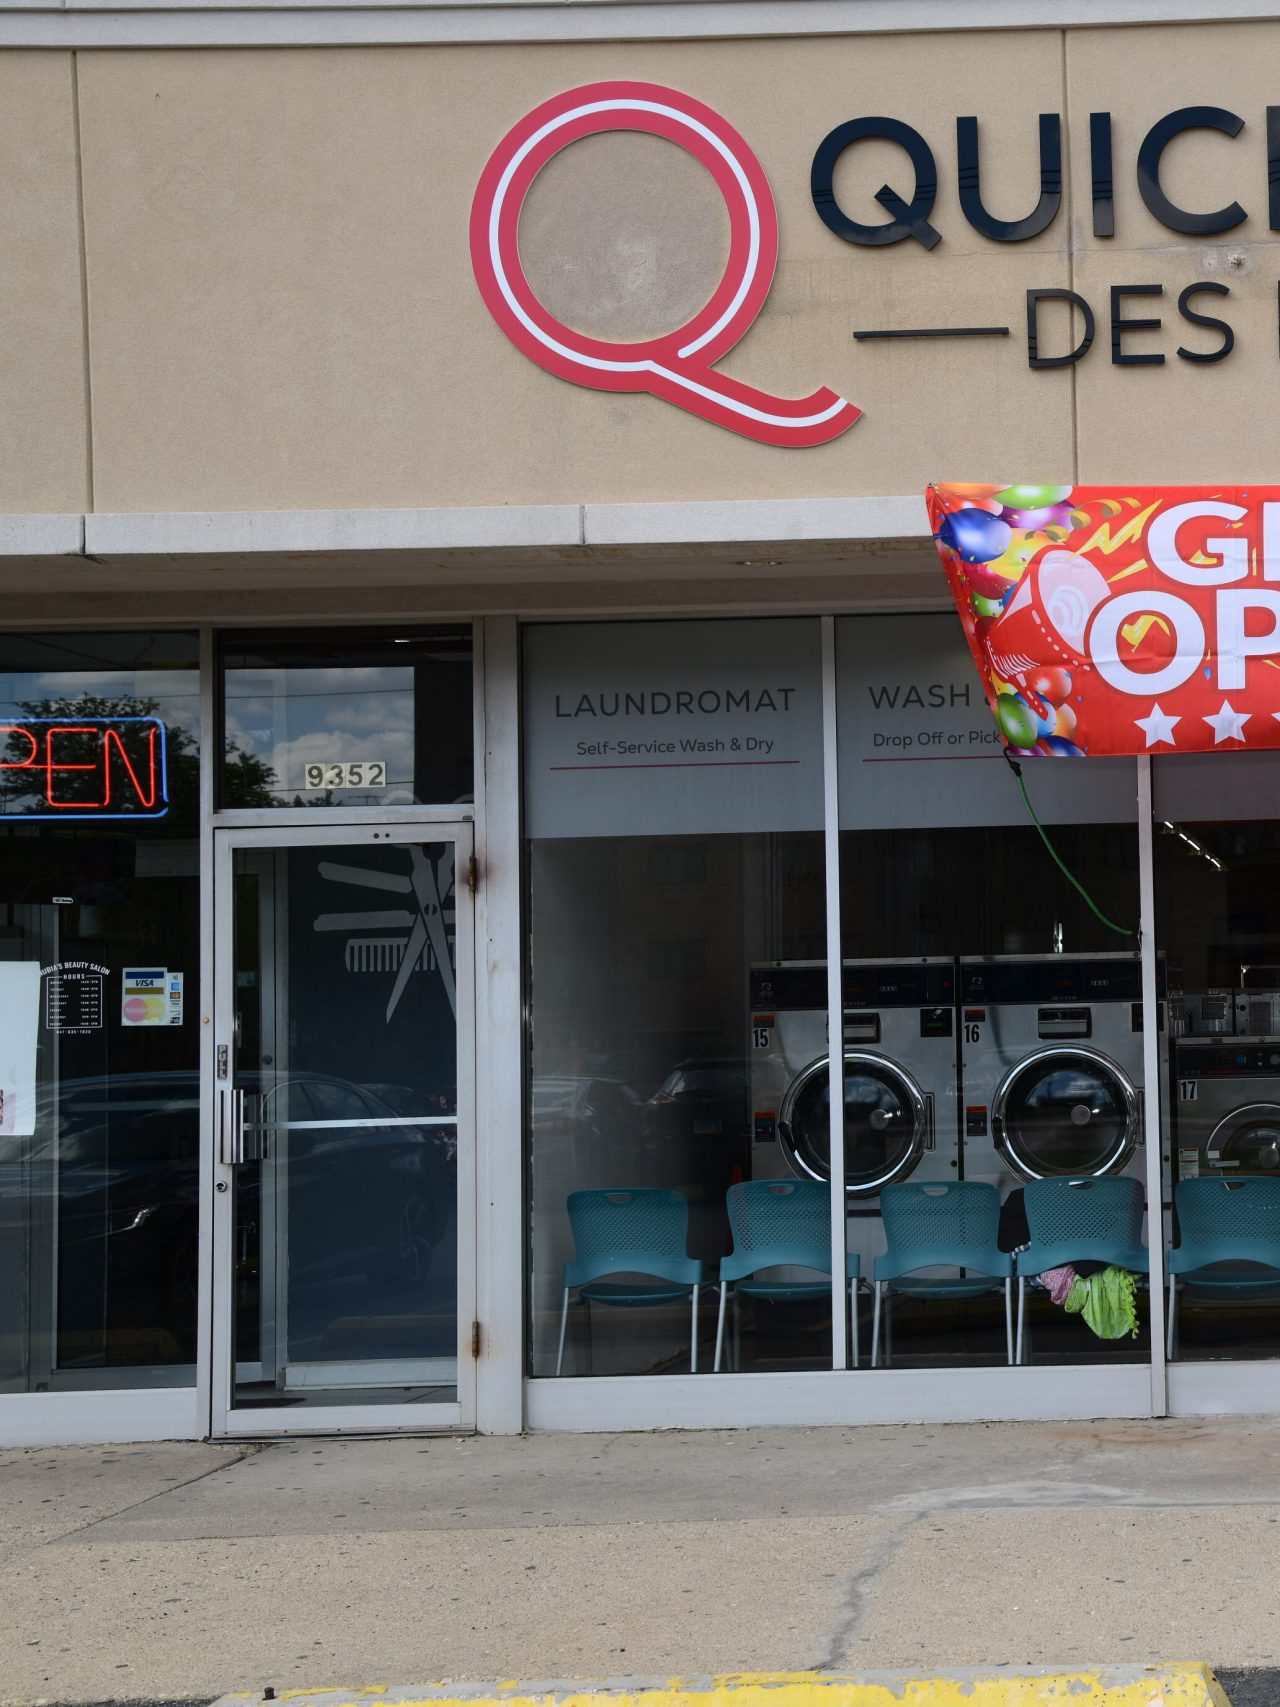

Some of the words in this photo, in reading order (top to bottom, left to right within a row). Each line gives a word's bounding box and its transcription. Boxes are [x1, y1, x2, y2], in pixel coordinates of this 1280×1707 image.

[469, 80, 864, 448] Q
[1028, 281, 1235, 370] DES
[555, 688, 796, 718] LAUNDROMAT
[868, 683, 970, 709] WASH
[576, 740, 676, 755] Self-Service
[679, 738, 725, 753] Wash
[730, 737, 742, 752] &
[746, 737, 774, 754] Dry
[873, 733, 913, 749] Drop
[917, 732, 944, 746] Off
[947, 734, 964, 745] or
[307, 763, 385, 788] 9352
[64, 961, 89, 969] BEAUTY
[89, 963, 111, 976] SALON
[135, 979, 154, 987] VISA
[753, 1029, 769, 1048] 15
[964, 1024, 980, 1043] 16
[218, 1045, 227, 1080] PULL
[1180, 1080, 1197, 1100] 17
